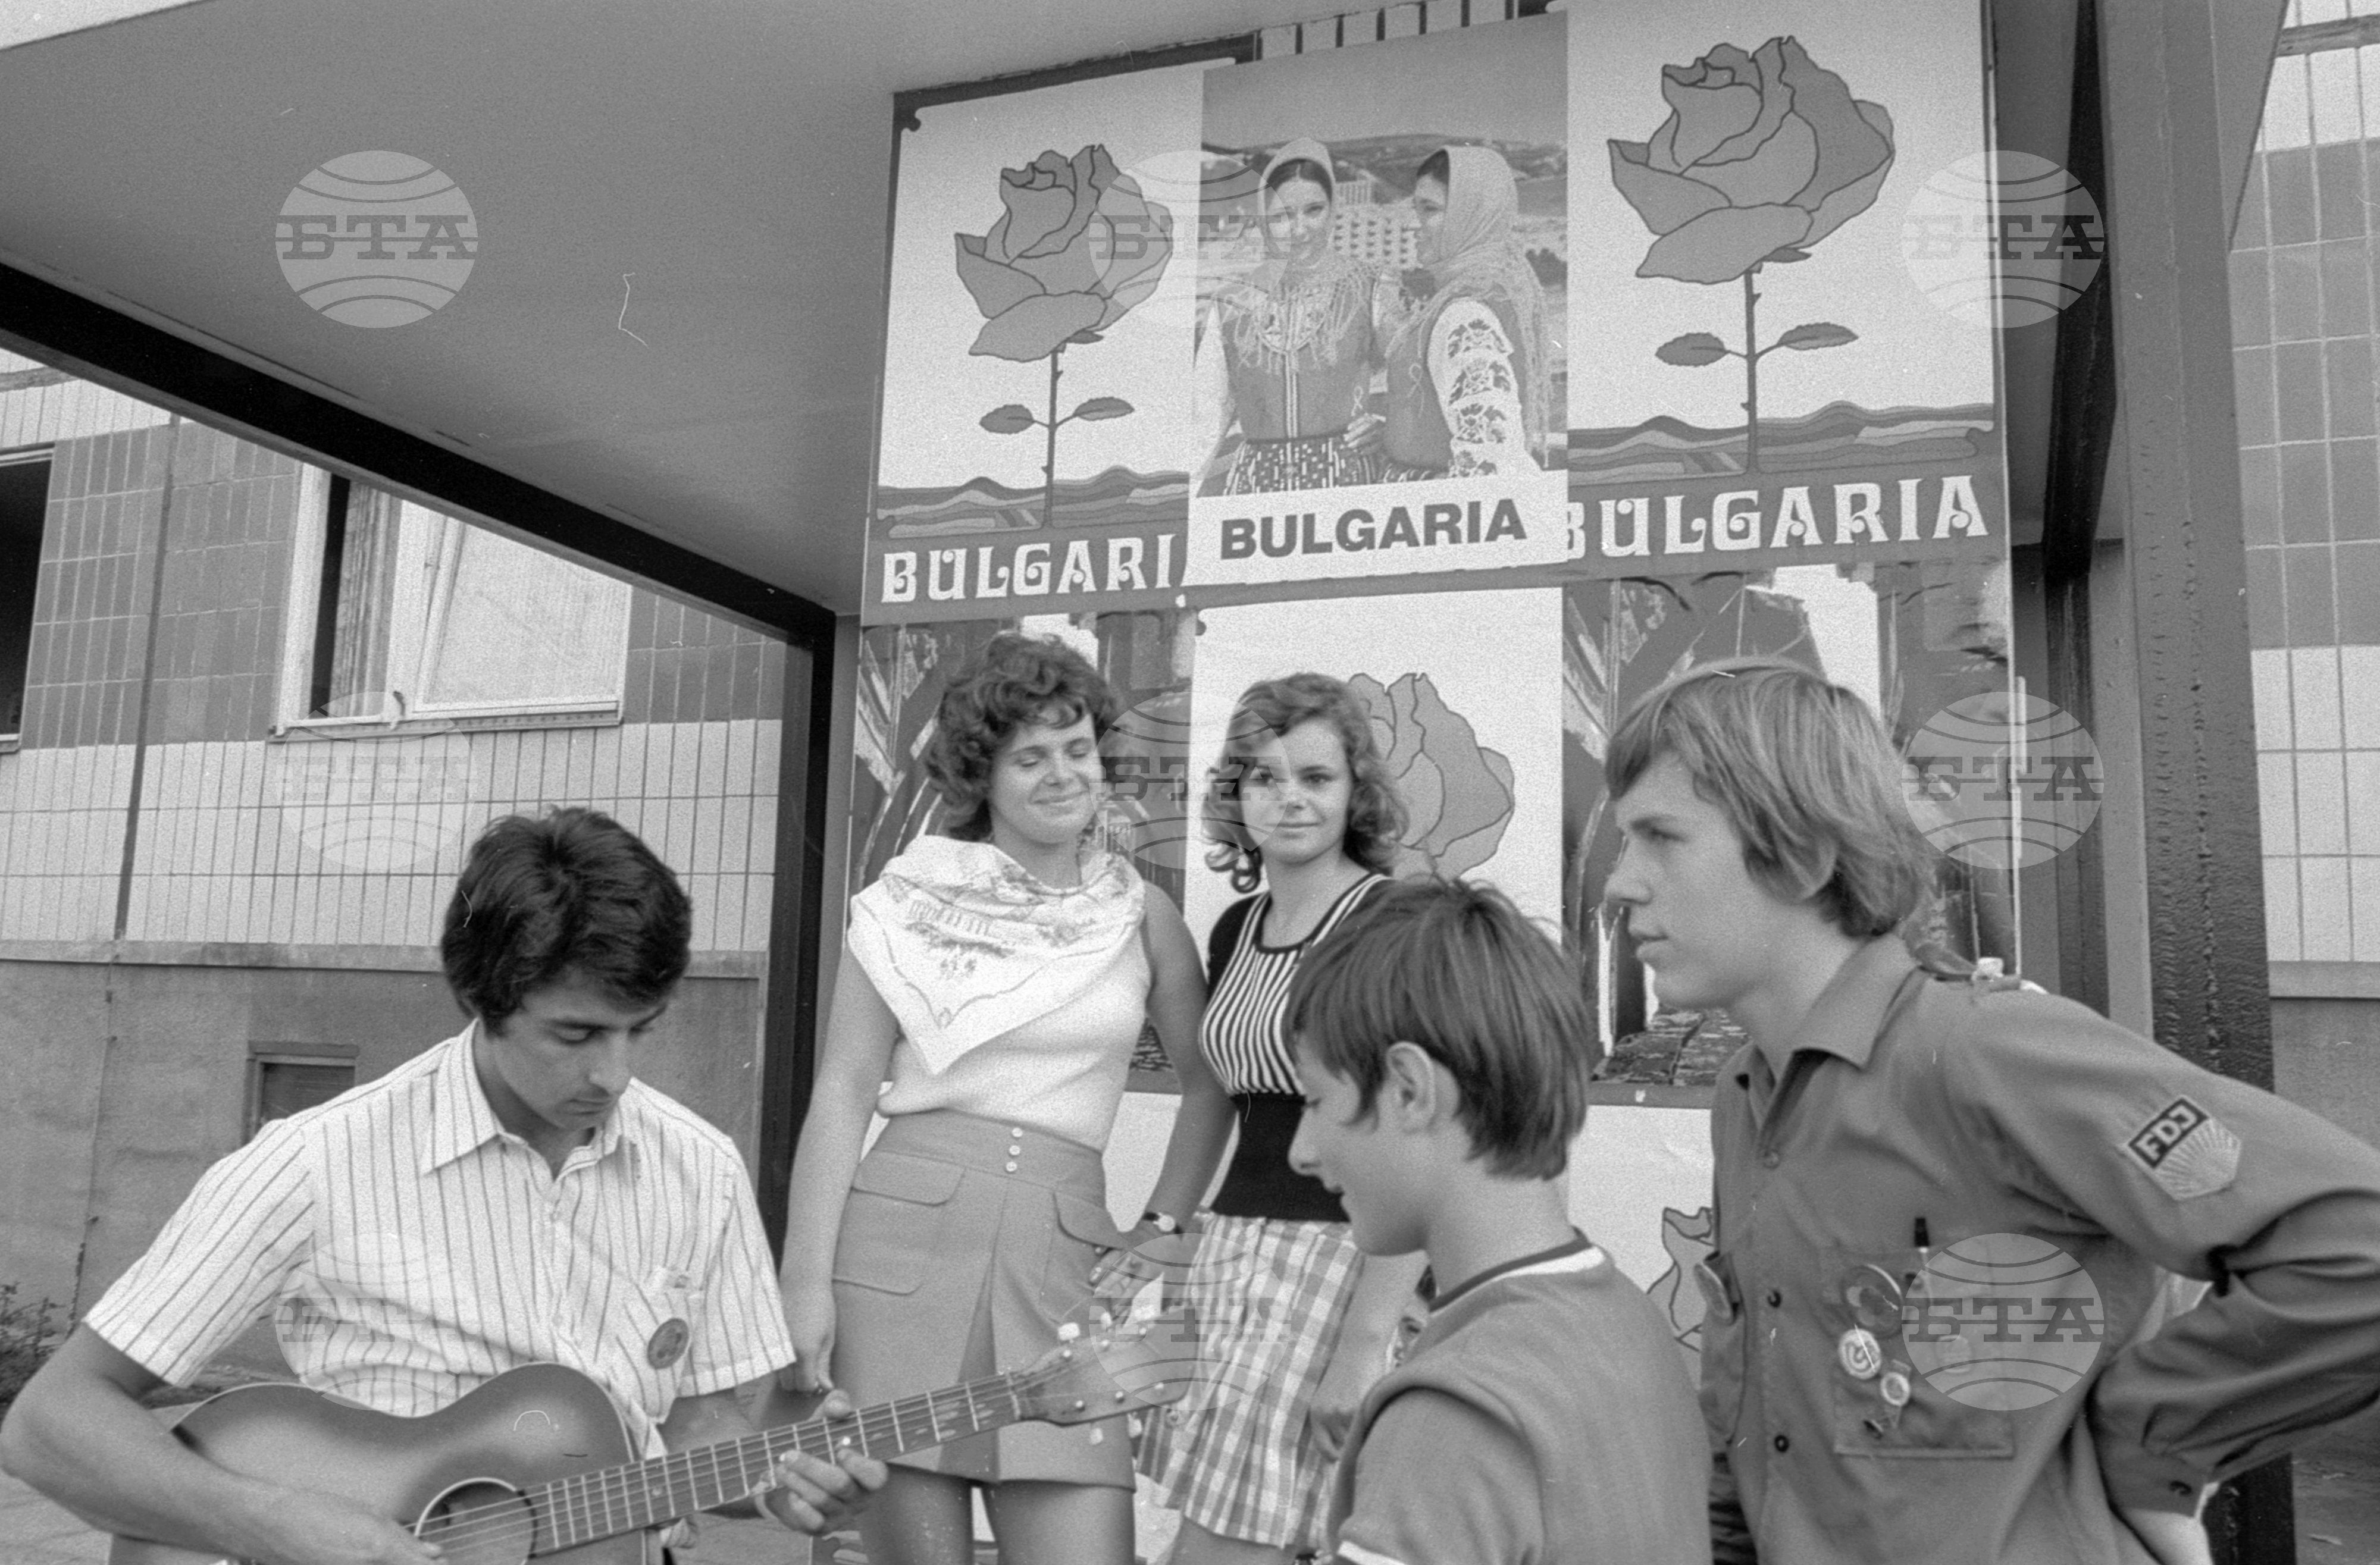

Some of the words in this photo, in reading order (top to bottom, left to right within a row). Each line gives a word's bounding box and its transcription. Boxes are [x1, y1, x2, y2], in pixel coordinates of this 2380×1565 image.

[1220, 498, 1527, 560] BULGARIA
[881, 534, 1188, 603] BULGARI
[2136, 1105, 2197, 1161] FDJ
